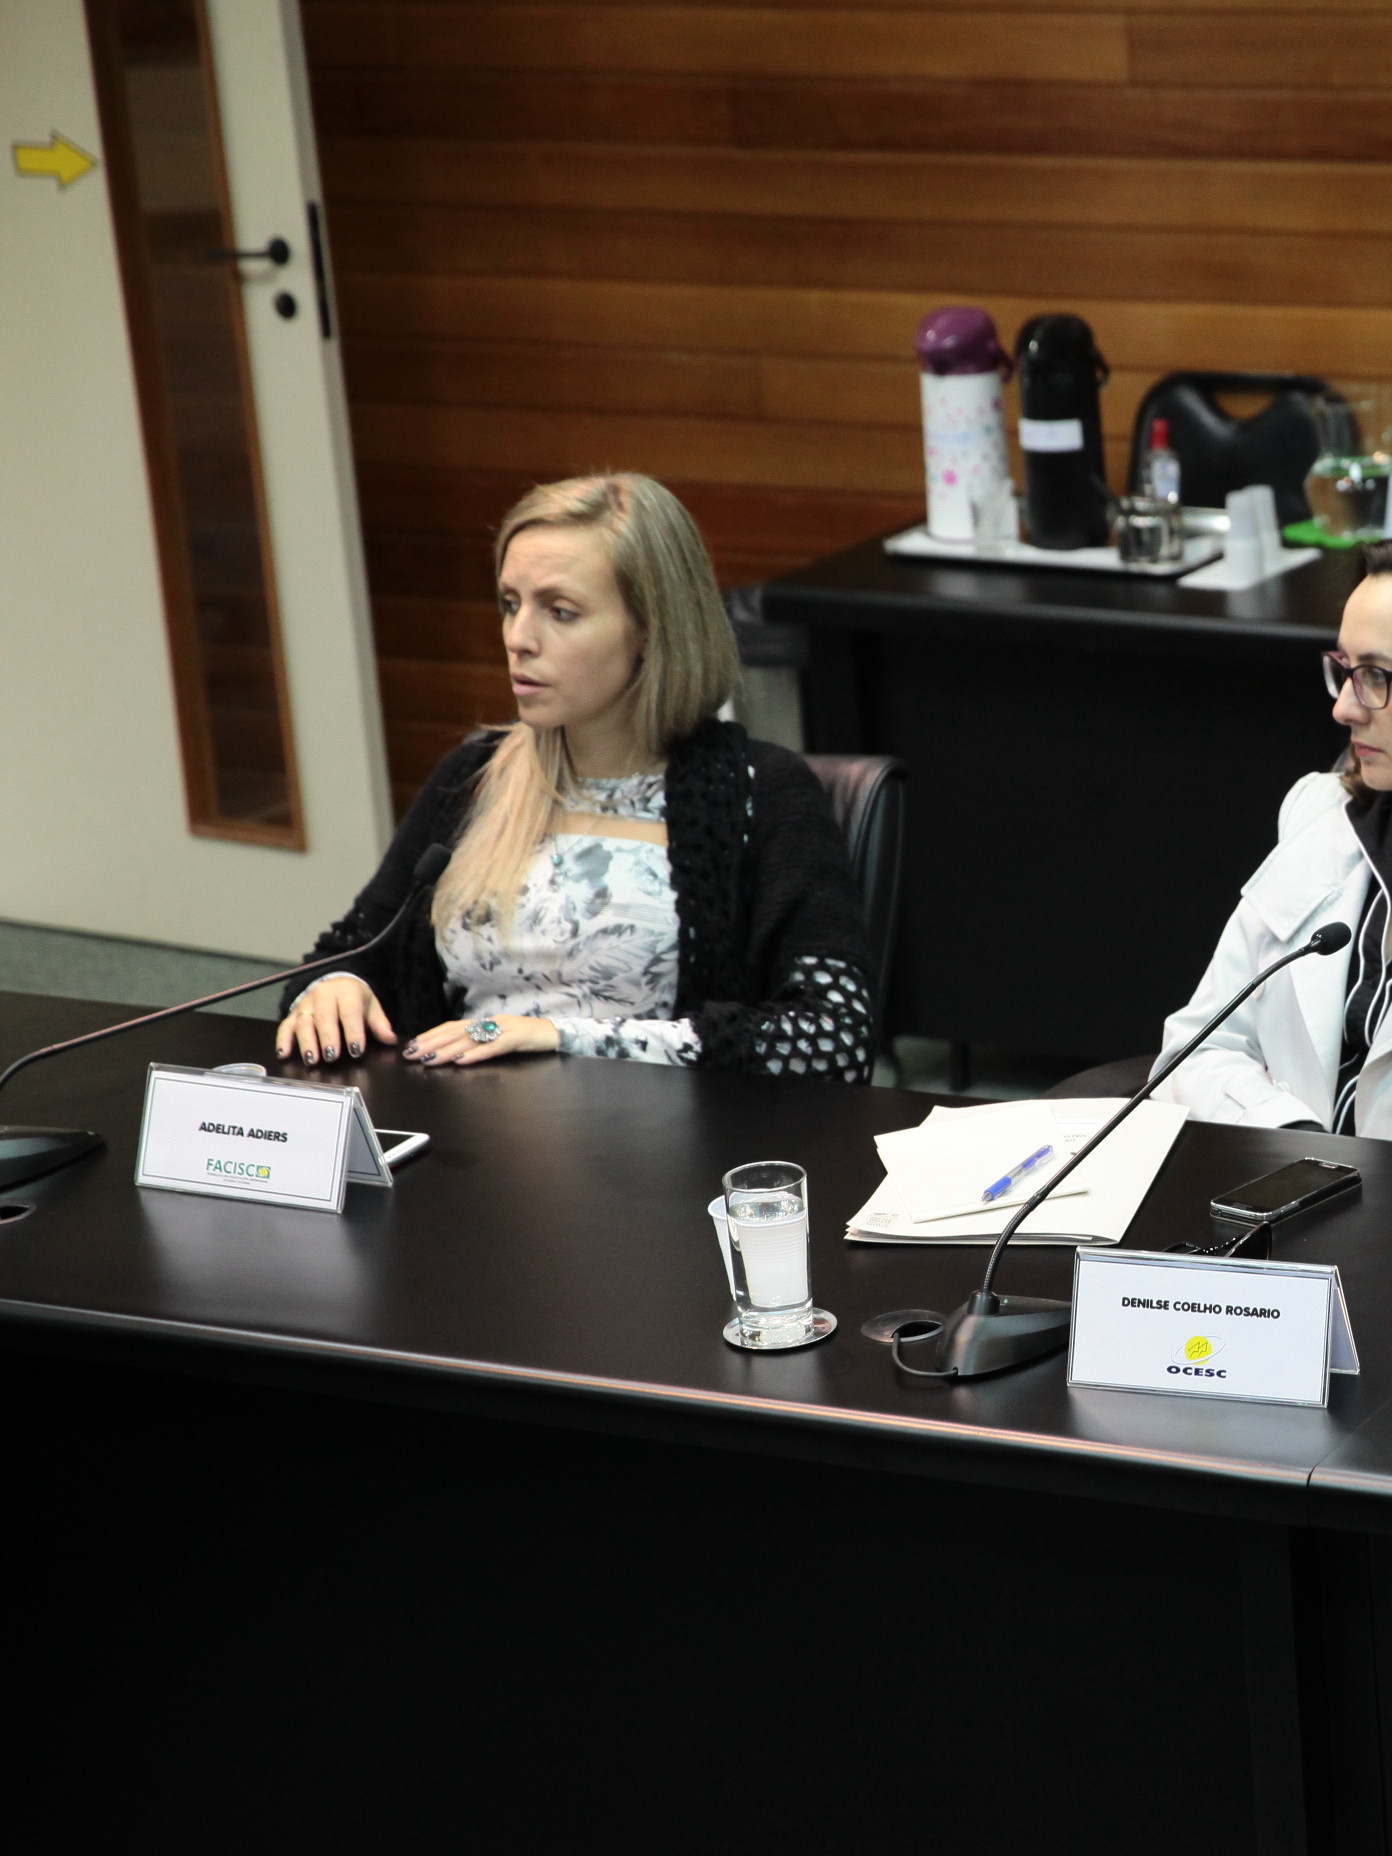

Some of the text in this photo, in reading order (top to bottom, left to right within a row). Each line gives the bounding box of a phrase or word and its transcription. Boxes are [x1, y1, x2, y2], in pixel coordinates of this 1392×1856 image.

[199, 1121, 288, 1143] ADELITA ADIERS
[1121, 1296, 1281, 1319] DENILSE COELHO ROSARIO
[1166, 1365, 1227, 1379] OCESC
